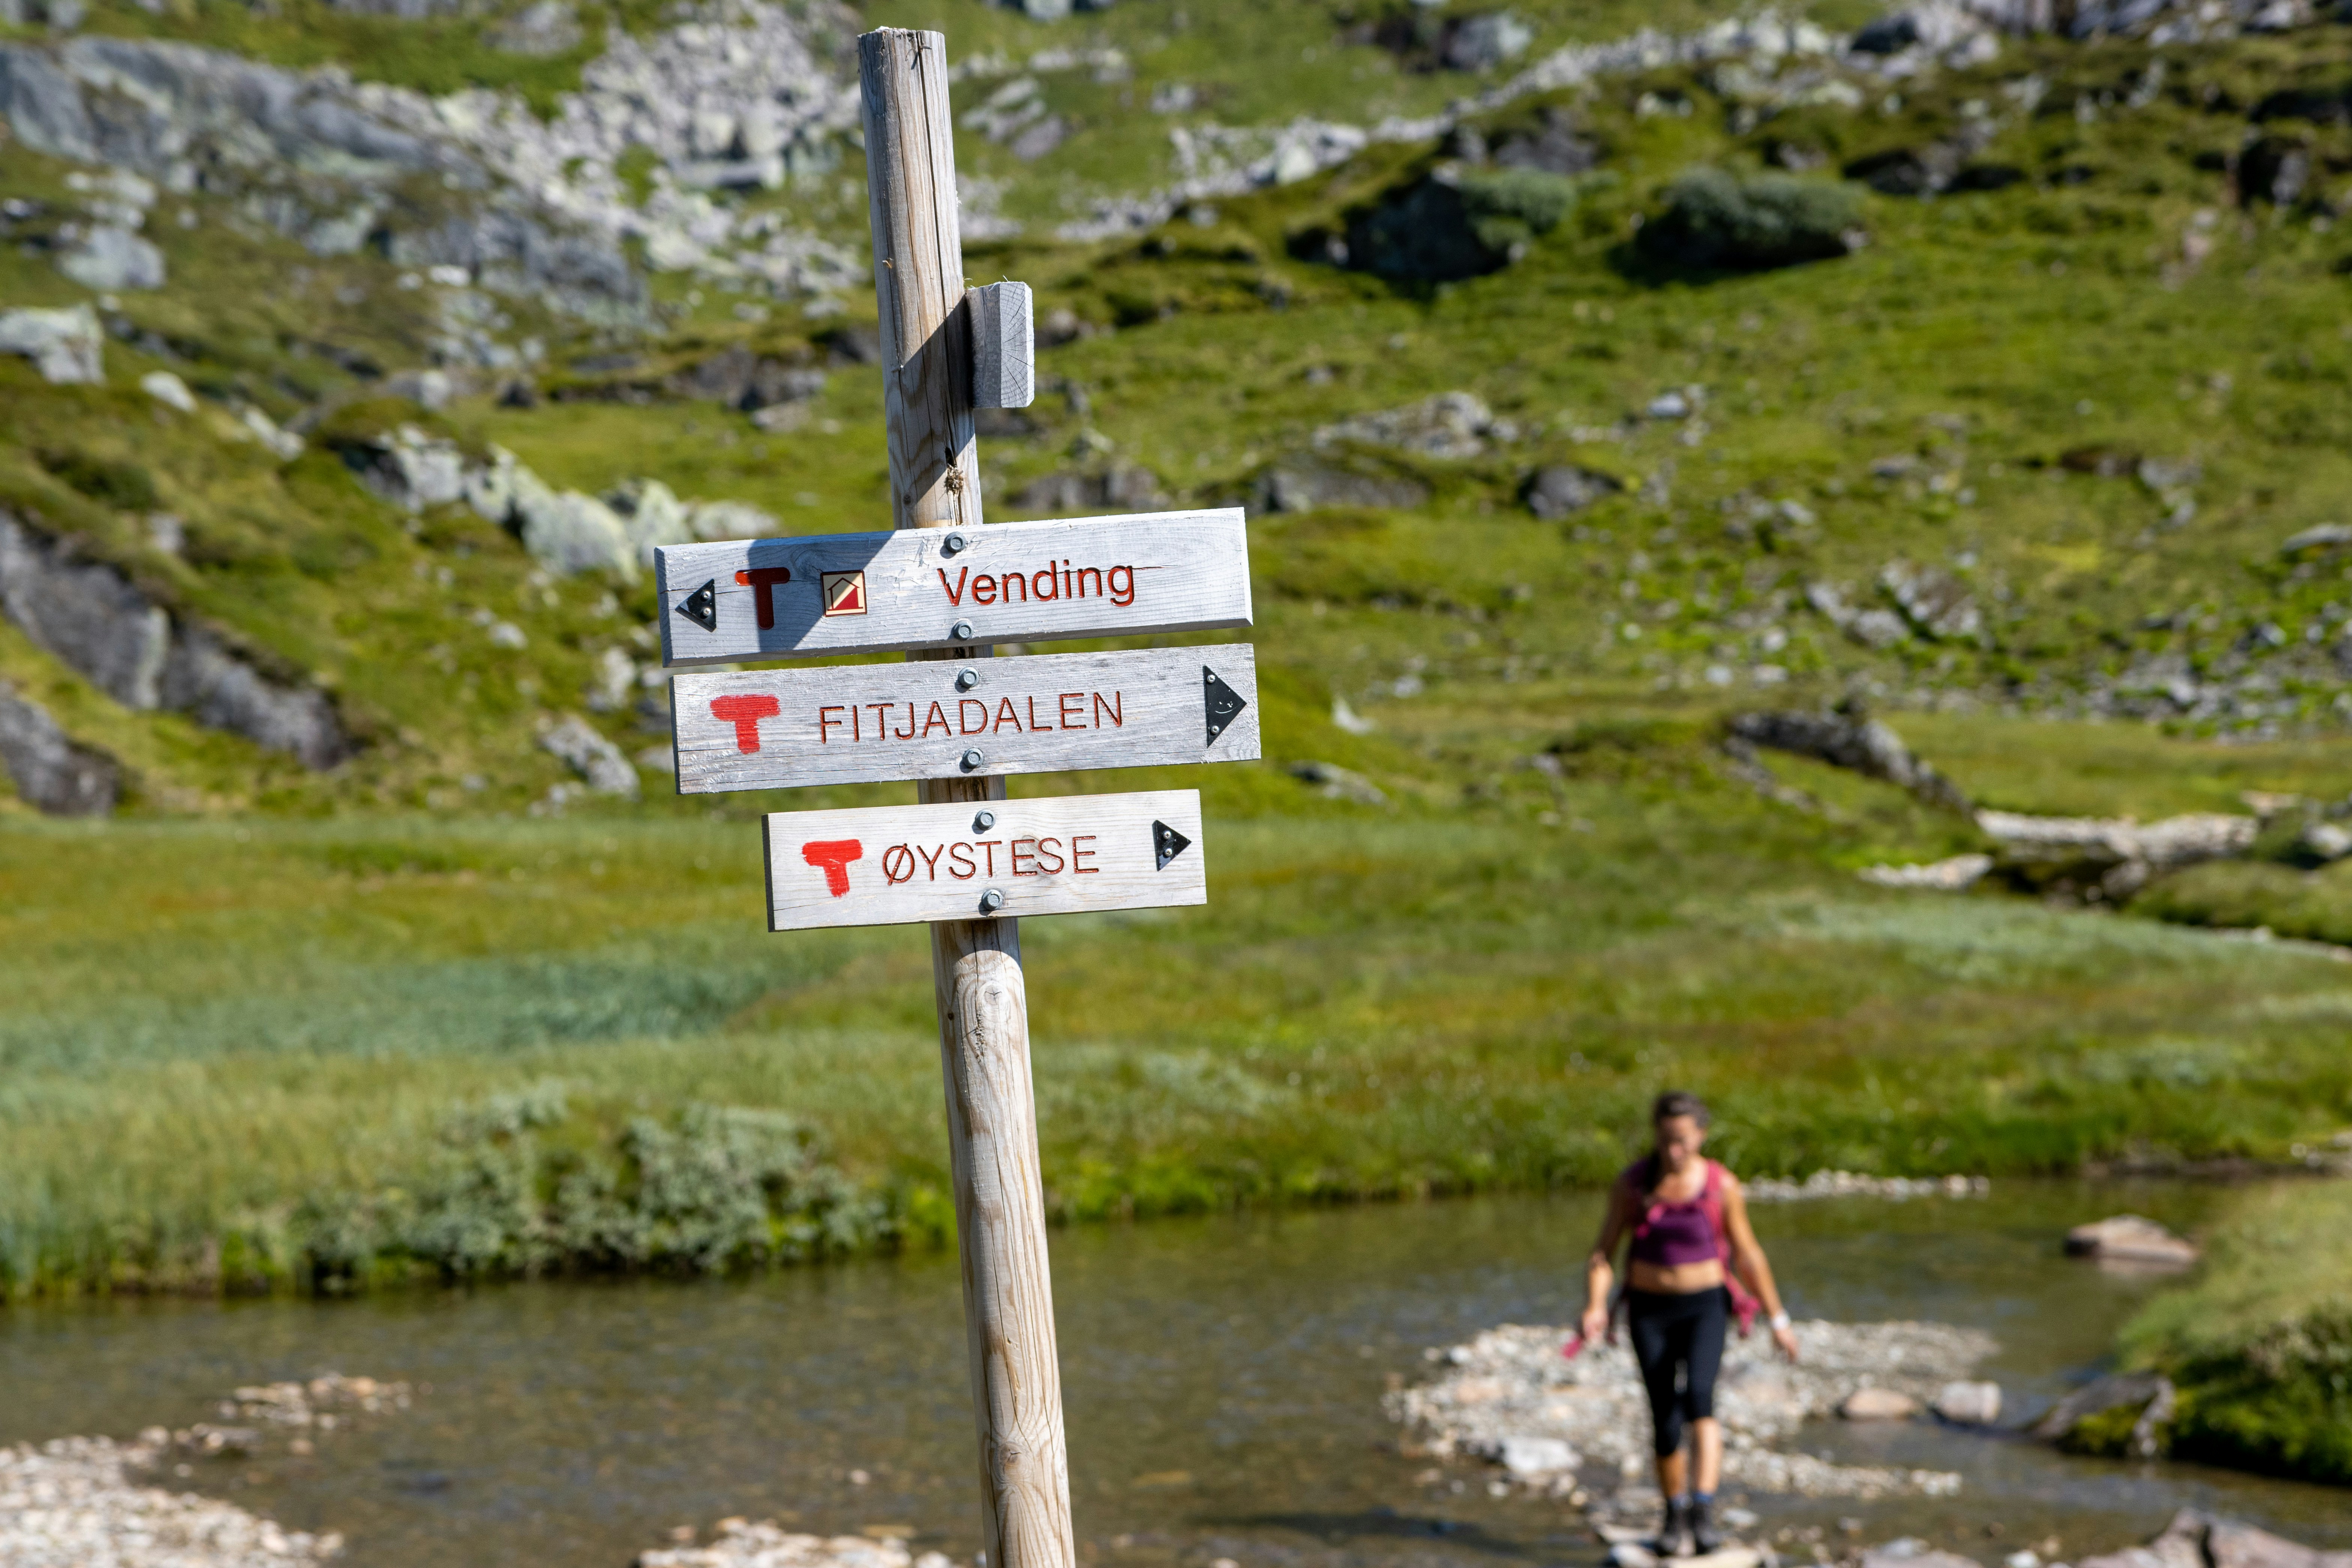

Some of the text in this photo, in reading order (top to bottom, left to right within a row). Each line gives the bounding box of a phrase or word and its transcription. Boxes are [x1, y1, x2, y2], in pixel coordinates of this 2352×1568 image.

[735, 559, 1135, 630] T Vending
[819, 690, 1123, 744] FITJADALEN
[881, 835, 1099, 886] ØYSTESE
